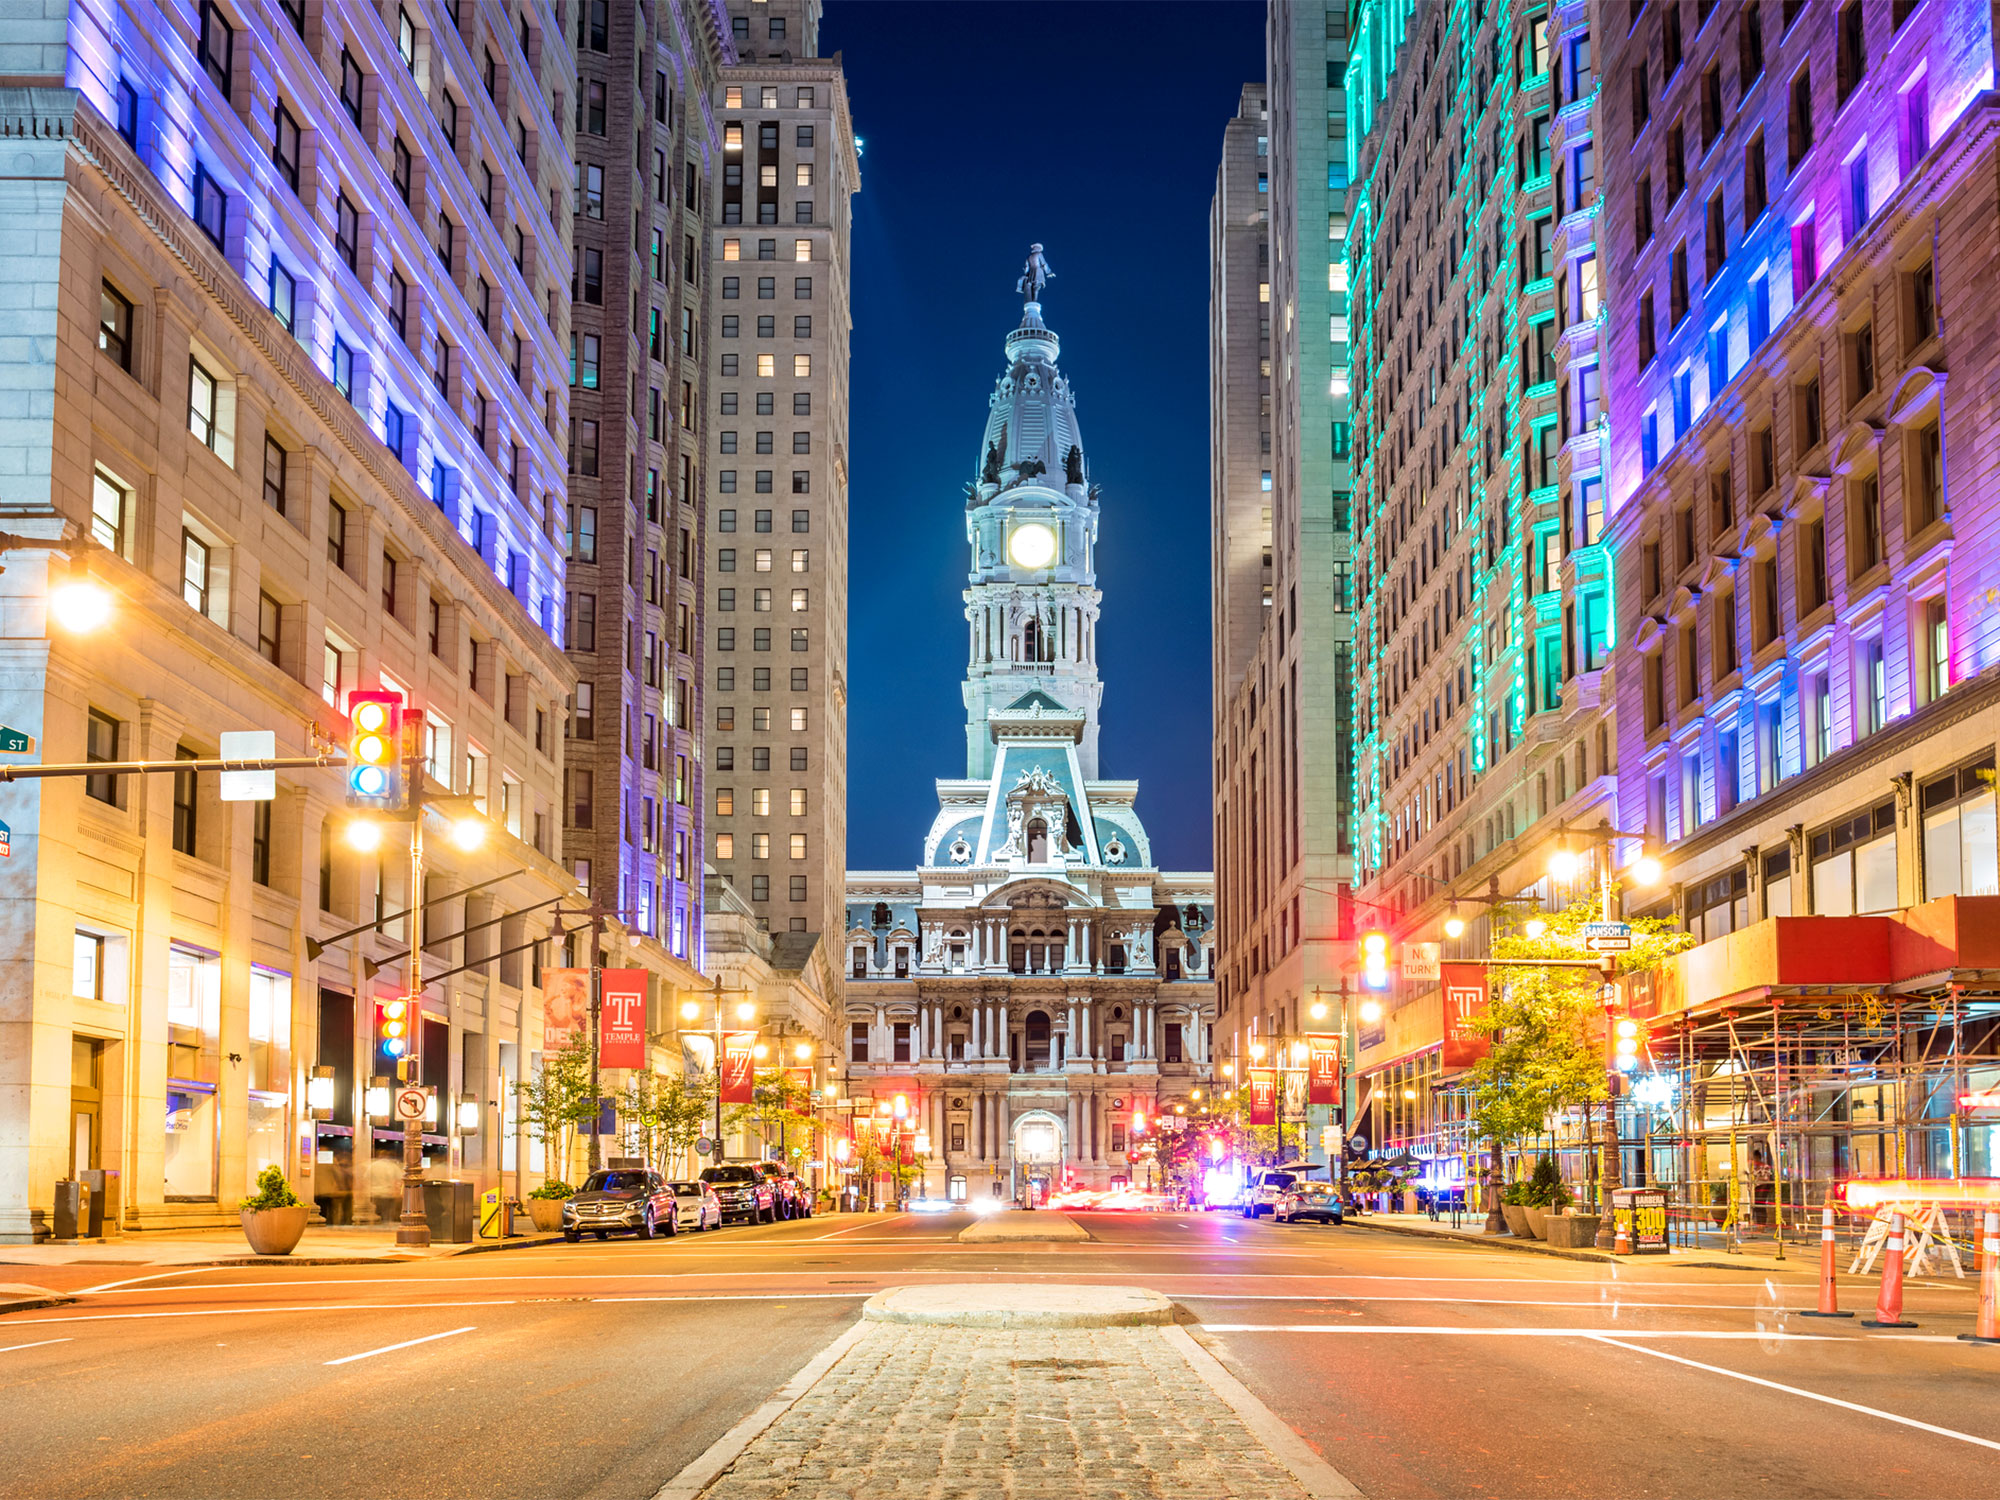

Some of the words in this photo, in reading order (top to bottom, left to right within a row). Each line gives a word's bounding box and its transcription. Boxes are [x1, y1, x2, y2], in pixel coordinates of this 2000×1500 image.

[9, 739, 25, 750] ST
[1586, 926, 1621, 936] SANSOM
[605, 1032, 641, 1041] TEMPLE
[1312, 1078, 1338, 1086] TEMPLE
[1635, 1206, 1666, 1230] 300
